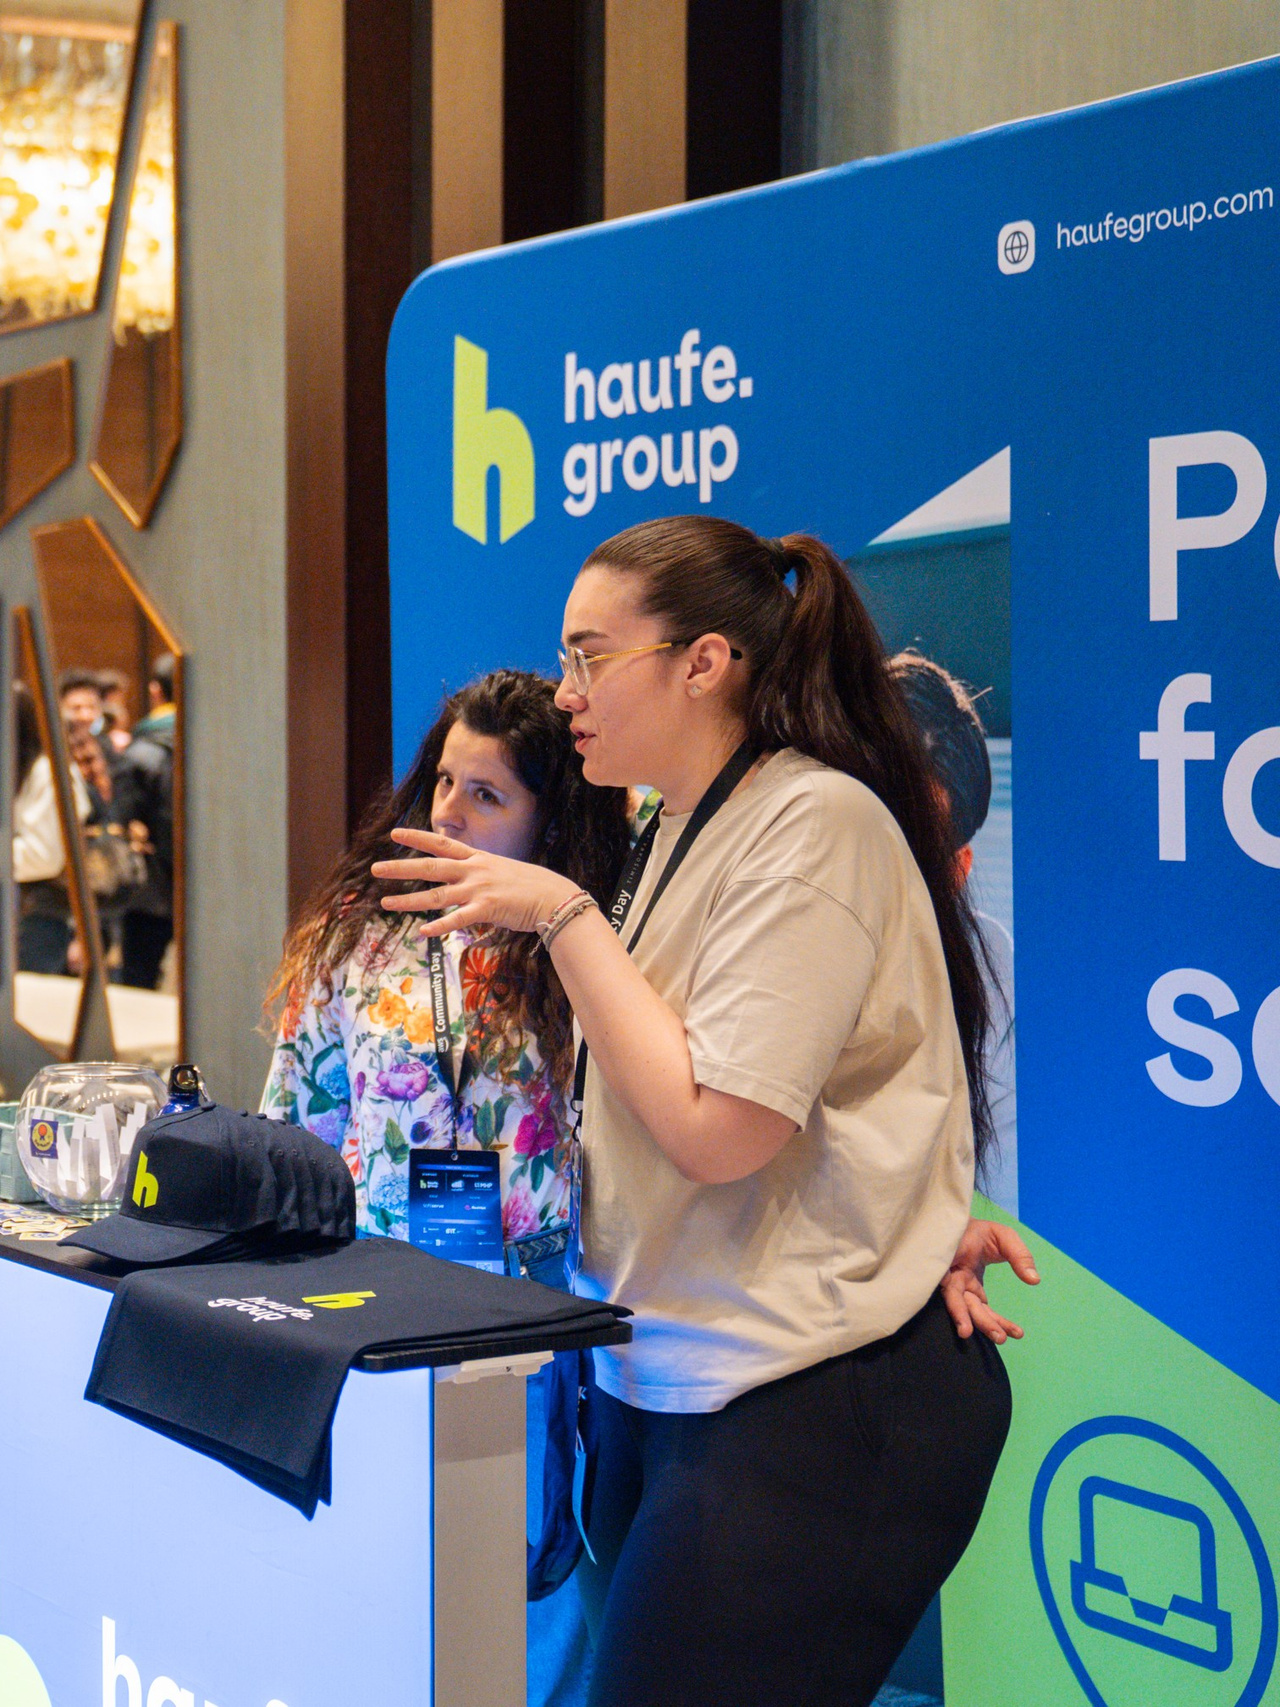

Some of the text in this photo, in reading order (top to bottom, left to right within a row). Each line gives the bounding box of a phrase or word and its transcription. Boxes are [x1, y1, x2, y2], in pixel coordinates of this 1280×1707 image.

[1057, 187, 1274, 249] haufegroup.com
[564, 328, 754, 424] haufe.
[562, 424, 740, 517] group
[1149, 430, 1280, 622] P
[611, 889, 632, 915] Day
[430, 952, 442, 973] Day
[431, 975, 446, 1033] Community
[437, 1037, 448, 1053] aws
[1145, 968, 1280, 1108] s
[208, 1298, 287, 1322] group
